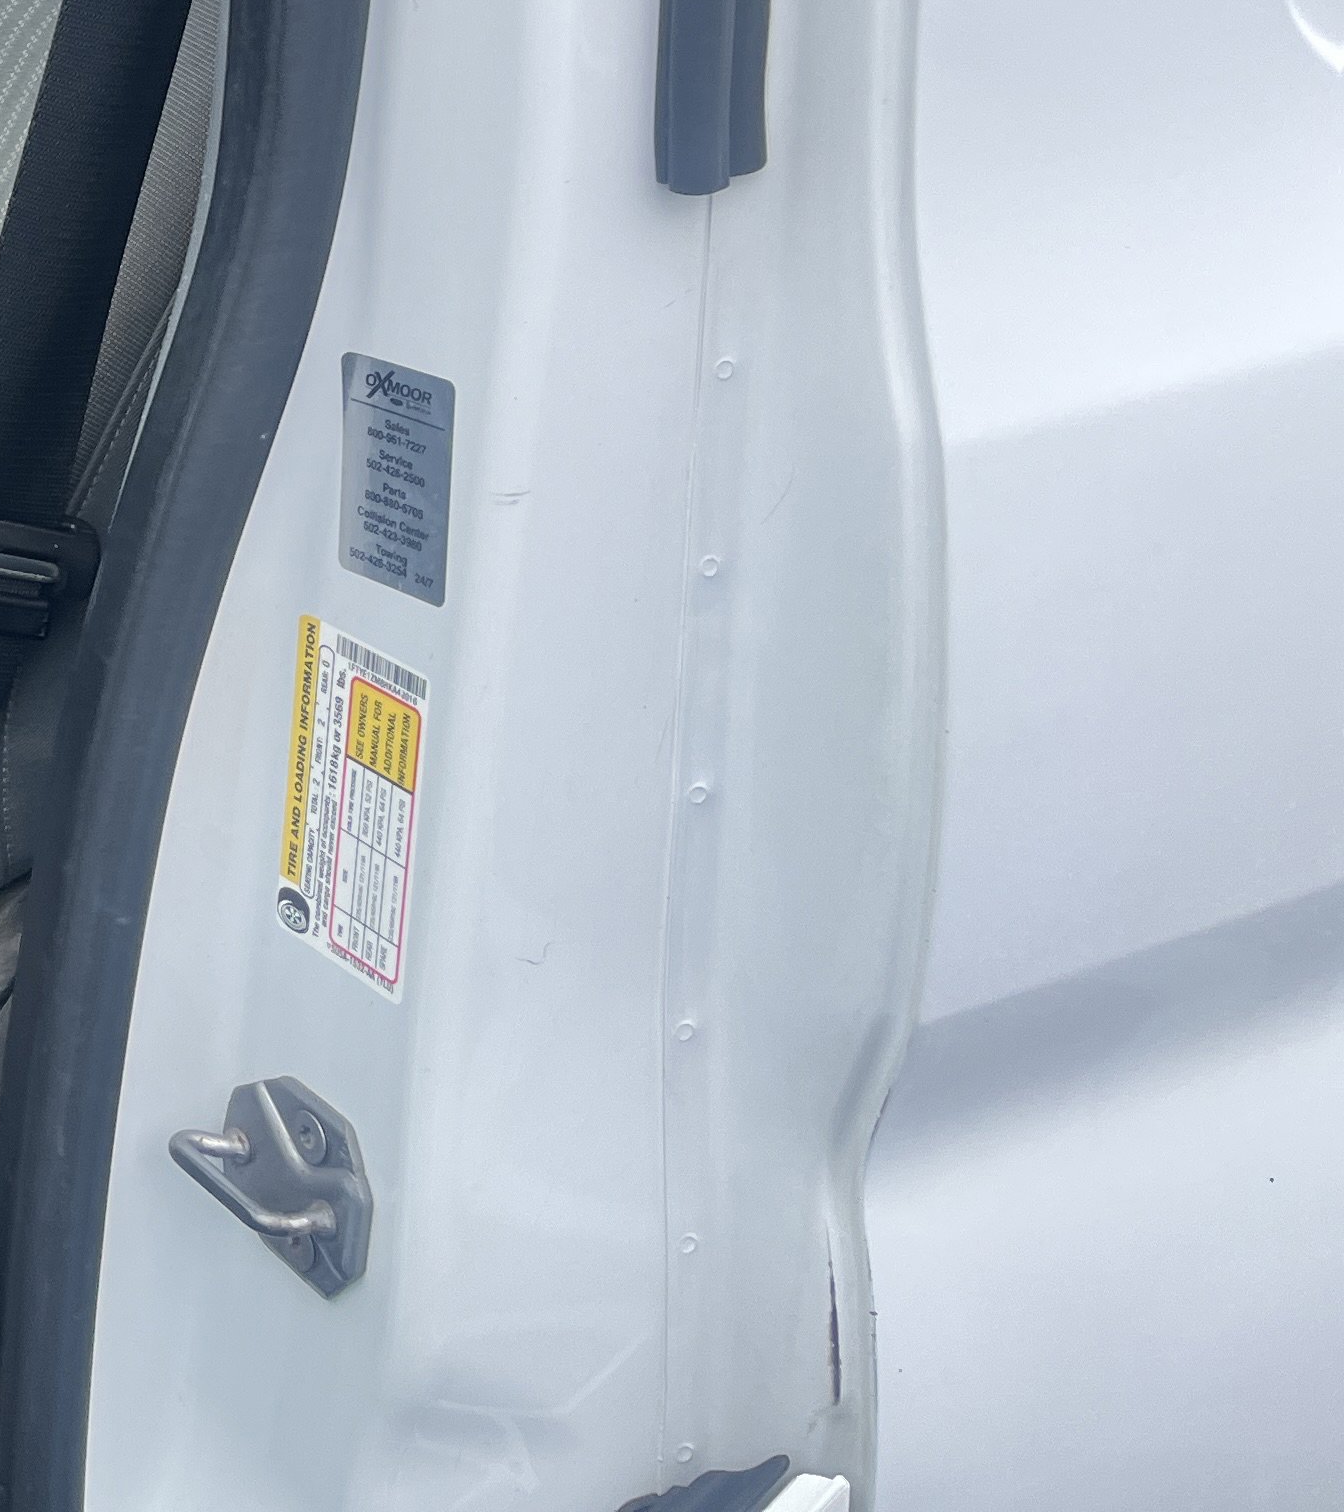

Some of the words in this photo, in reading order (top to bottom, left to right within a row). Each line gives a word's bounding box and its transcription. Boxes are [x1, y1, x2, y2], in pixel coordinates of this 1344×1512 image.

[385, 419, 410, 436] Sales
[379, 449, 413, 470] Service
[382, 482, 407, 500] Parts
[357, 505, 397, 529] Collision
[399, 521, 430, 541] Center
[376, 543, 408, 568] Towing
[300, 623, 316, 730] INFORMATION
[337, 666, 346, 689] lbs.
[333, 696, 344, 728] 3569
[357, 693, 368, 738] OWNERS
[374, 700, 382, 721] FOR
[334, 729, 341, 742] or
[356, 739, 364, 759] SEE
[370, 723, 380, 767] MANUAL
[384, 711, 396, 775] ADDITIONAL
[398, 713, 410, 785] INFORMATION
[294, 734, 307, 802] LOADING
[314, 778, 320, 786] 2
[291, 806, 300, 838] AND
[288, 842, 297, 877] TIRE
